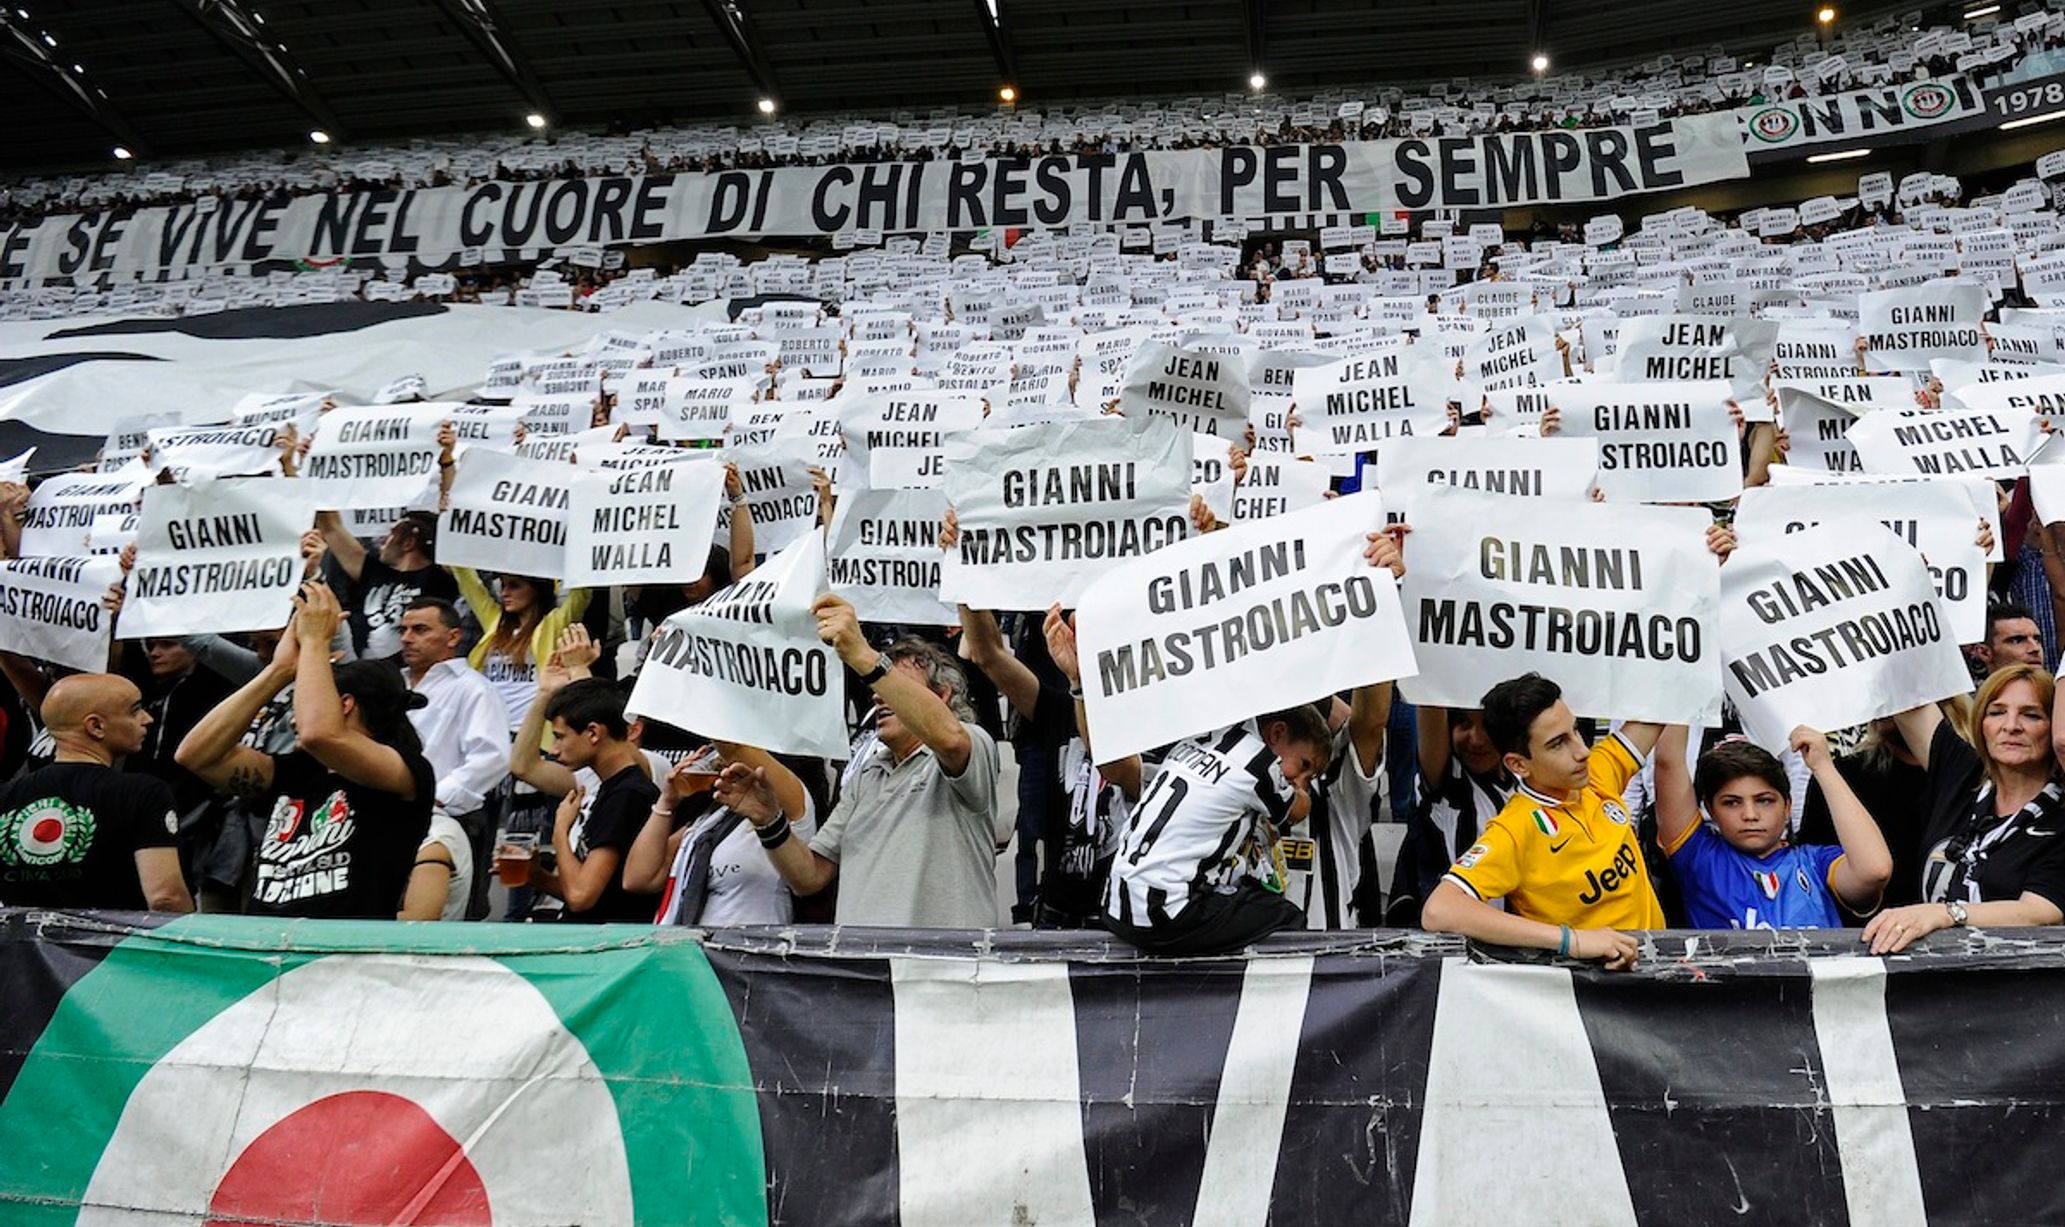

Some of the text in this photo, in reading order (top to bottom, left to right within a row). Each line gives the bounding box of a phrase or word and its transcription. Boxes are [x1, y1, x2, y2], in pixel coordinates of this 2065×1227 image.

[1994, 86, 2065, 117] 1978
[59, 210, 137, 273] SE
[160, 198, 291, 272] VIVE
[310, 189, 418, 256] NEL
[460, 177, 676, 247] CUORE
[706, 171, 774, 234] DI
[811, 163, 925, 231] CHI
[947, 152, 1177, 230] RESTA,
[1221, 144, 1351, 212] PER
[1394, 120, 1684, 208] SEMPRE
[1735, 266, 1793, 278] GIANFRANCO
[1282, 287, 1312, 298] MARIO
[1282, 299, 1313, 310] SPANU
[1333, 293, 1363, 303] MARIO
[1382, 301, 1414, 310] MARIO
[1477, 292, 1519, 305] CLAUDE
[1692, 295, 1736, 308] CLAUDE
[1477, 307, 1519, 319] ROBERT
[1890, 303, 1956, 325] GIANNI
[781, 338, 831, 351] ROBERTO
[1095, 338, 1132, 353] MARIO
[1487, 326, 1527, 354] JEAN
[1662, 323, 1726, 347] JEAN
[1868, 328, 1979, 351] MASTROIACO
[659, 346, 705, 362] ROBERTO
[1480, 347, 1538, 379] MICHEL
[1776, 341, 1838, 361] GIANNI
[698, 362, 749, 381] SPANU
[1164, 355, 1220, 382] JEAN
[1339, 354, 1399, 384] JEAN
[1646, 357, 1736, 381] MICHEL
[684, 387, 734, 401] MARIO
[1008, 378, 1049, 394] MARIO
[1148, 380, 1226, 411] MICHEL
[1326, 384, 1416, 416] MICHEL
[680, 405, 730, 422] SPANU
[881, 401, 939, 423] JEAN
[1594, 402, 1692, 433] GIANNI
[338, 415, 411, 443] GIANNI
[1332, 418, 1414, 446] WALLA
[1893, 412, 2010, 448] MICHEL
[308, 451, 433, 480] MASTROIACO
[1912, 444, 2024, 475] WALLA
[609, 468, 675, 496] JEAN
[1003, 461, 1138, 509] GIANNI
[592, 503, 681, 534] MICHEL
[716, 494, 816, 530] ASROIACO
[167, 511, 263, 552] GIANNI
[960, 513, 1190, 567] MASTROIACO
[591, 542, 673, 572] WALLA
[1480, 535, 1645, 592] GIANNI
[135, 554, 294, 600] MASTROIACO
[1147, 538, 1307, 616] GIANNI
[1745, 553, 1892, 626] GIANNI
[1096, 574, 1380, 700] MASTROIACO
[1418, 597, 1703, 666] MASTROIACO
[652, 624, 828, 697] MASTROIACO
[1728, 600, 1943, 701] MASTROIACO
[1579, 842, 1638, 906] Jeep
